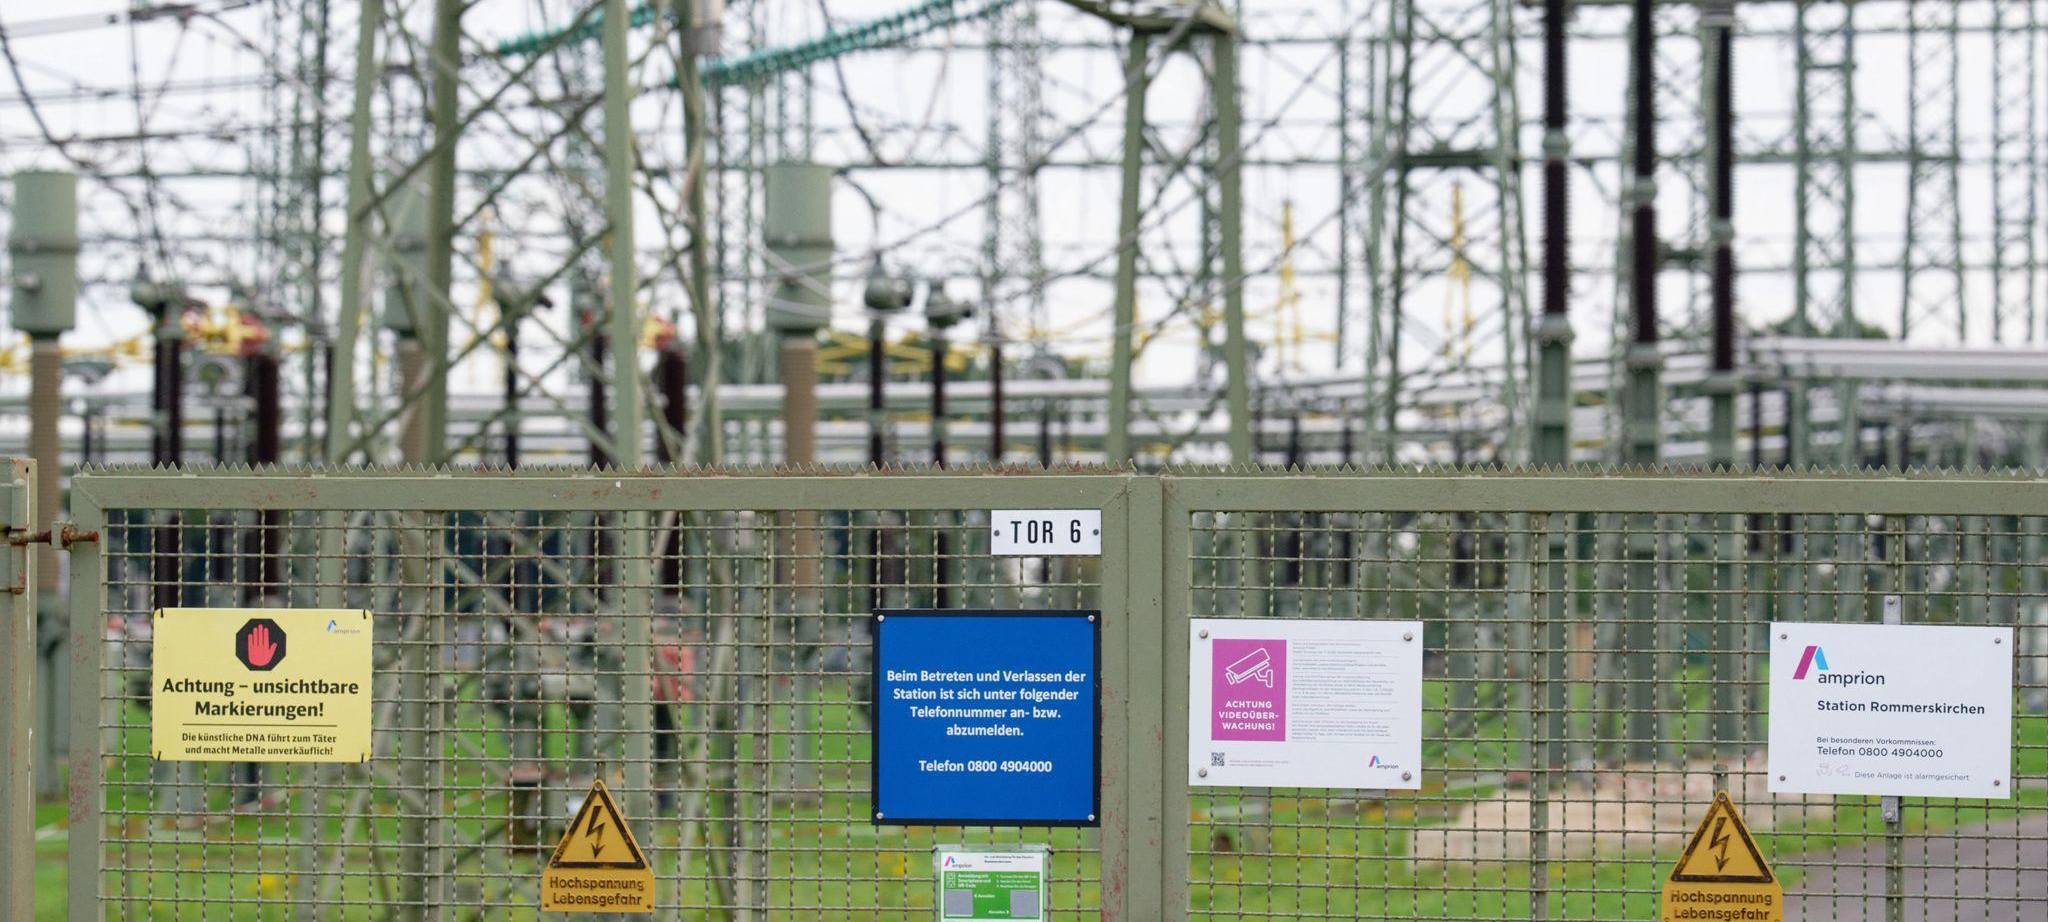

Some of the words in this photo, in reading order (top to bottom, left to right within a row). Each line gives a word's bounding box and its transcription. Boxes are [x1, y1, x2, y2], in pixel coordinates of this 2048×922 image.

[1010, 520, 1053, 543] TOR
[1070, 519, 1081, 543] 6
[887, 670, 917, 682] Beim
[920, 670, 973, 682] Betreten
[976, 670, 1000, 682] und
[1003, 670, 1062, 682] Verlassen
[1064, 671, 1086, 682] der
[1818, 671, 1885, 687] amprion
[162, 678, 235, 697] Achtung
[253, 679, 359, 694] unsichtbare
[893, 688, 936, 700] Station
[940, 688, 954, 700] ist
[957, 688, 980, 700] sich
[983, 689, 1016, 700] unter
[1020, 688, 1079, 702] folgender
[195, 701, 324, 720] Markierungen!
[1225, 701, 1272, 709] ACHTUNG
[1817, 700, 1866, 712] Station
[1870, 701, 1985, 715] Rommerskirchen
[910, 706, 1007, 718] Telefonnummer
[1010, 708, 1030, 718] an-
[1033, 706, 1061, 718] bzw.
[1218, 710, 1279, 720] VIDEOÜBER-
[946, 724, 1024, 736] abzumelden.
[1222, 722, 1275, 731] WACHUNG!
[182, 733, 197, 742] Die
[198, 732, 244, 742] künstliche
[245, 733, 265, 742] DNA
[267, 733, 291, 743] führt
[292, 735, 311, 743] zum
[312, 733, 337, 743] Täter
[1876, 738, 1936, 746] Vorkommnissen:
[185, 746, 202, 754] und
[203, 746, 230, 754] macht
[232, 746, 266, 755] Metalle
[267, 746, 333, 756] unverkäuflich!
[1817, 746, 1855, 756] Telefon
[1858, 748, 1888, 757] 0800
[1891, 748, 1943, 758] 4904000
[919, 759, 964, 772] Telefon
[967, 760, 997, 772] 0800
[1000, 760, 1053, 772] 4904000
[1877, 772, 1902, 781] Anlage
[1914, 773, 1969, 782] alarmgesichert
[550, 876, 644, 891] Hochspannung
[553, 893, 642, 907] Lebensgefahr
[1671, 890, 1772, 905] Hochspannung
[1674, 907, 1770, 921] Lebensgefahr
